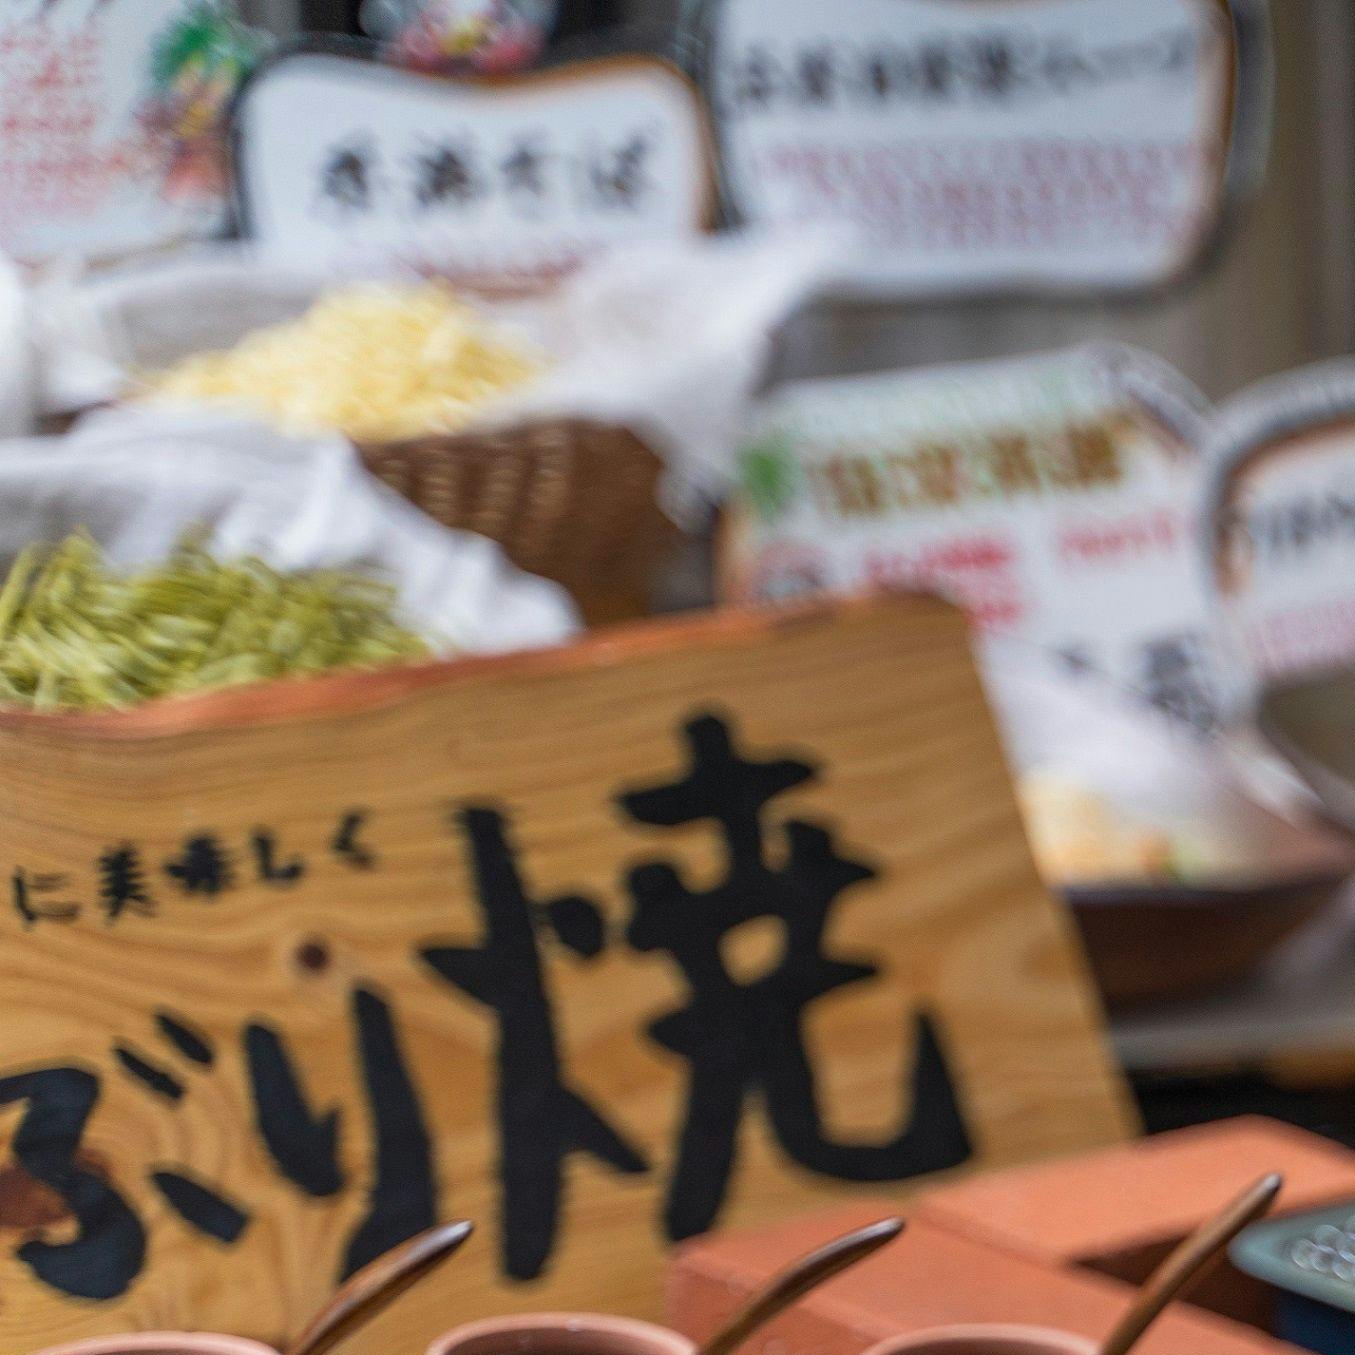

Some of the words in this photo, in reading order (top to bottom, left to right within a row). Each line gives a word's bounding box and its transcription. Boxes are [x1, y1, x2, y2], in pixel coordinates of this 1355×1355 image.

[12, 808, 378, 928] に美味しく
